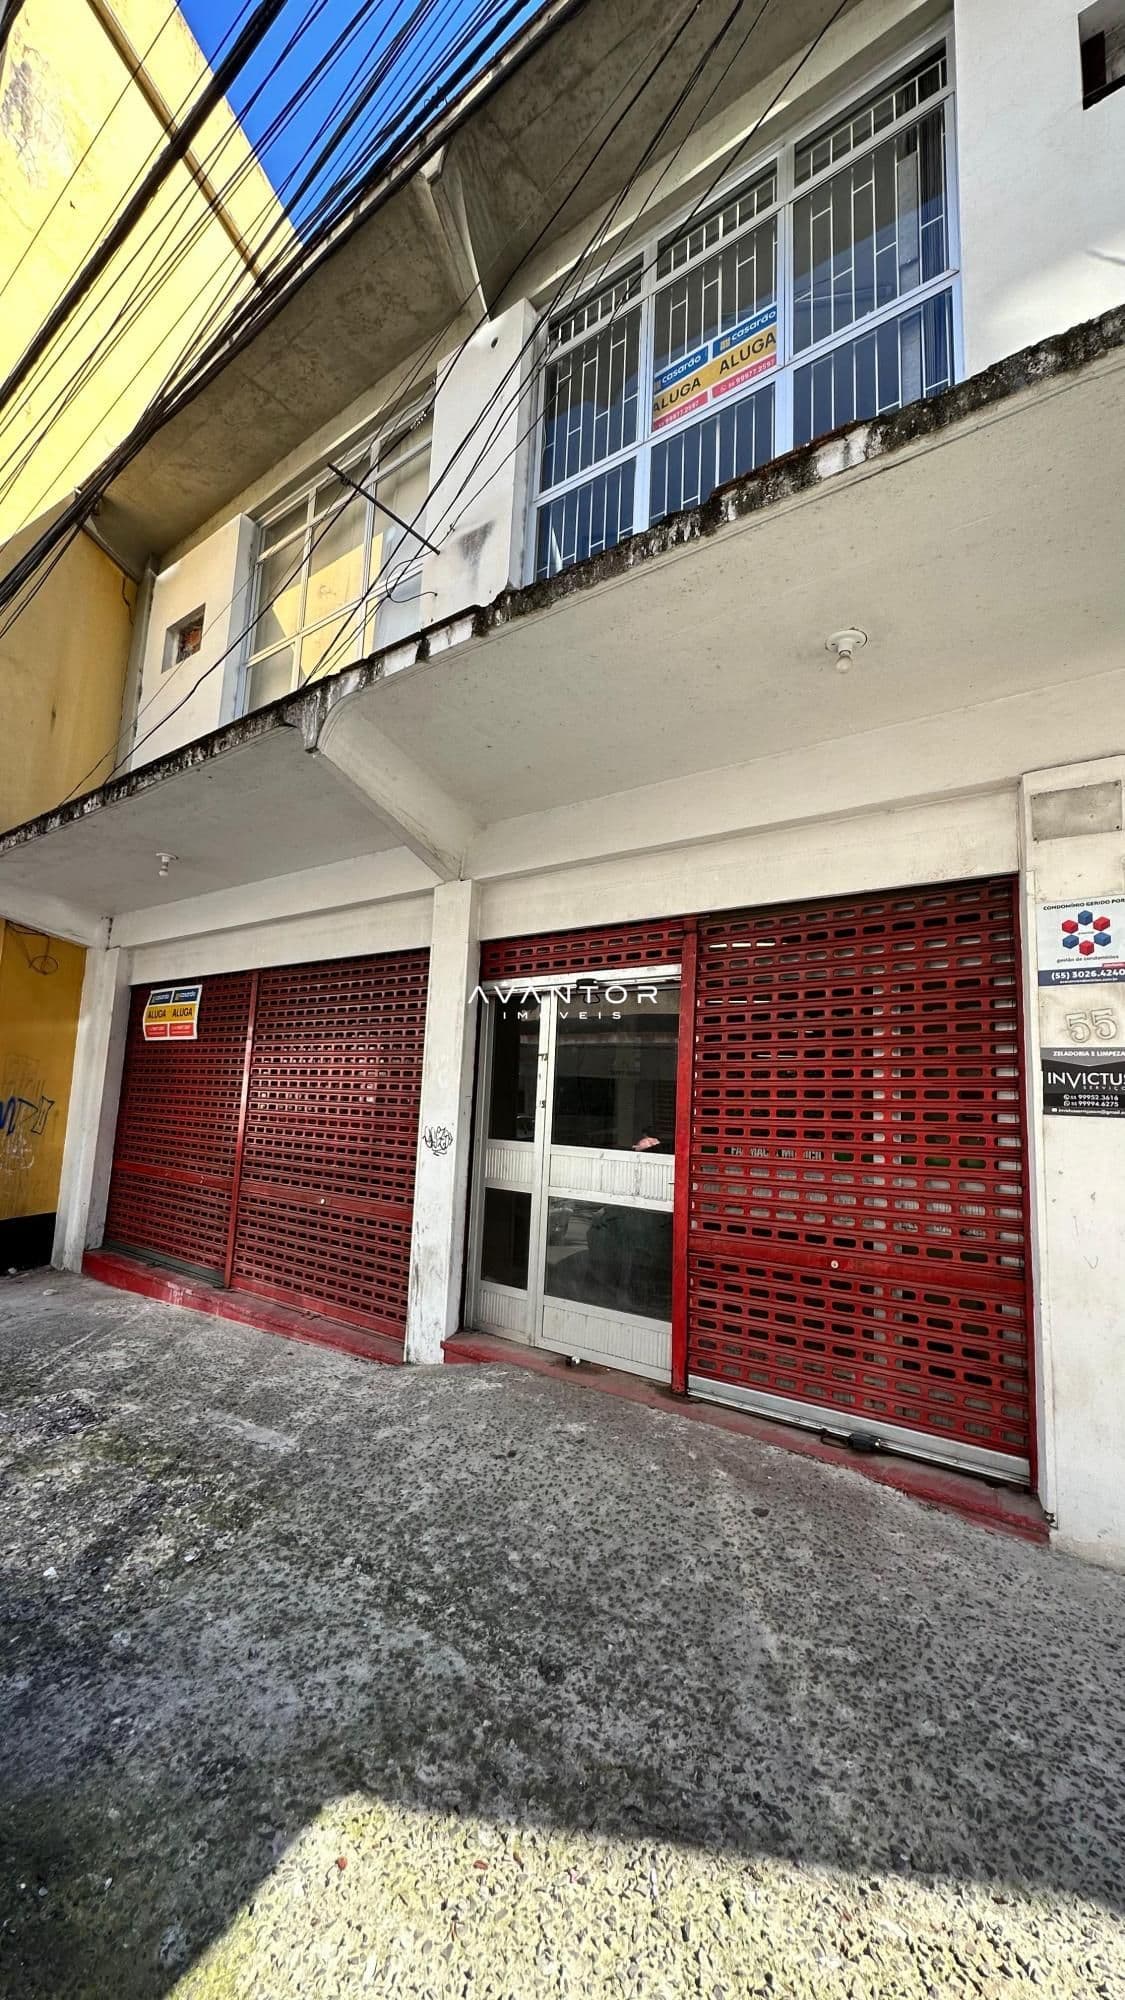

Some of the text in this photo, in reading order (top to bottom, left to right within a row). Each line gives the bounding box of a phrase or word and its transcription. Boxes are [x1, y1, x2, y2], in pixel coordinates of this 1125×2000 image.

[719, 332, 777, 374] ALUGA
[653, 377, 702, 412] ALUGA
[1051, 971, 1070, 981] (55)
[1072, 968, 1125, 978] 3026.4240
[172, 1007, 192, 1017] ALUGA
[1065, 1008, 1118, 1043] 55
